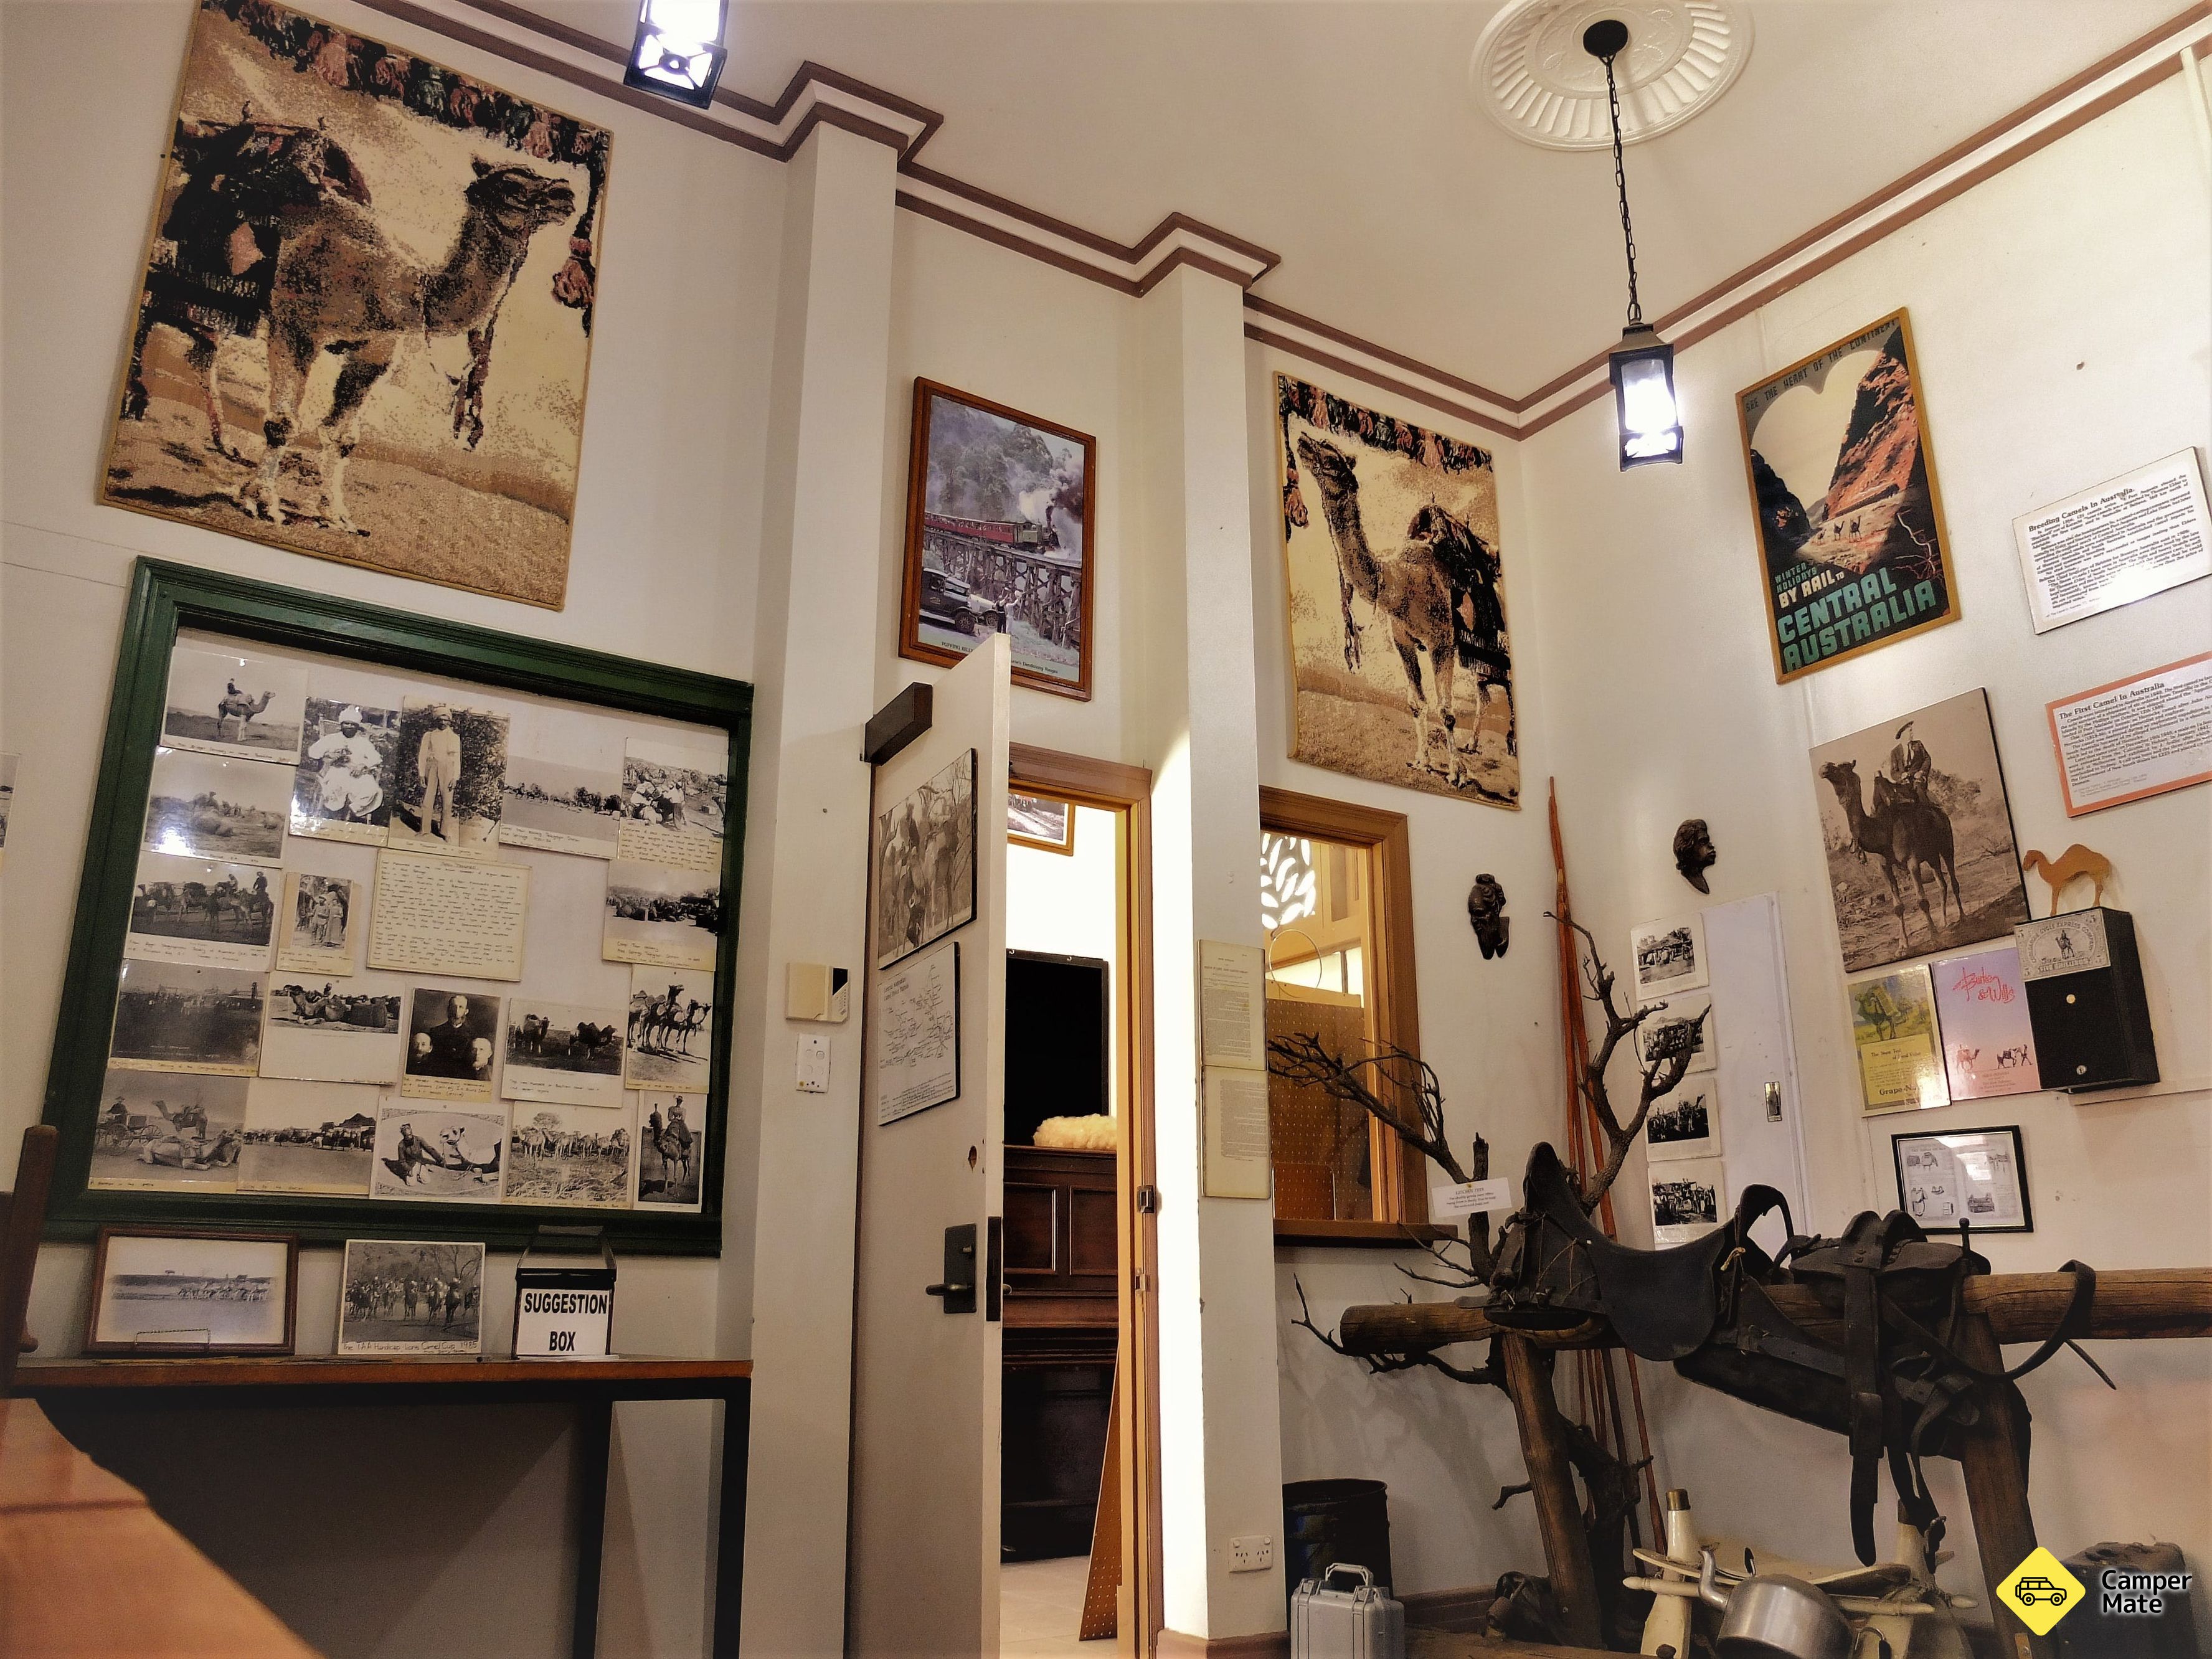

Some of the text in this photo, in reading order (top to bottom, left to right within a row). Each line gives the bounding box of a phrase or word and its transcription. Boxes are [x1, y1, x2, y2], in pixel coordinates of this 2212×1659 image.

[1764, 386, 1778, 401] THE
[1784, 368, 1808, 389] HEART
[1813, 359, 1823, 372] OF
[1828, 348, 1843, 363] THE
[2029, 516, 2060, 532] Breeding
[2061, 505, 2089, 519] Camels
[2090, 500, 2098, 509] In
[1775, 562, 1807, 584] WINTER
[1776, 567, 1817, 593] HOLIDAYS
[1779, 570, 1845, 608] BY RAIL TO
[1777, 567, 1897, 644] CENTRAL
[1784, 580, 1936, 673] AUSTRALIA
[2059, 711, 2073, 720] The
[2074, 705, 2091, 715] First
[2092, 697, 2117, 709] Camel
[2130, 682, 2165, 697] Australia
[524, 1293, 608, 1314] SUGGESTION
[549, 1331, 575, 1351] BOX
